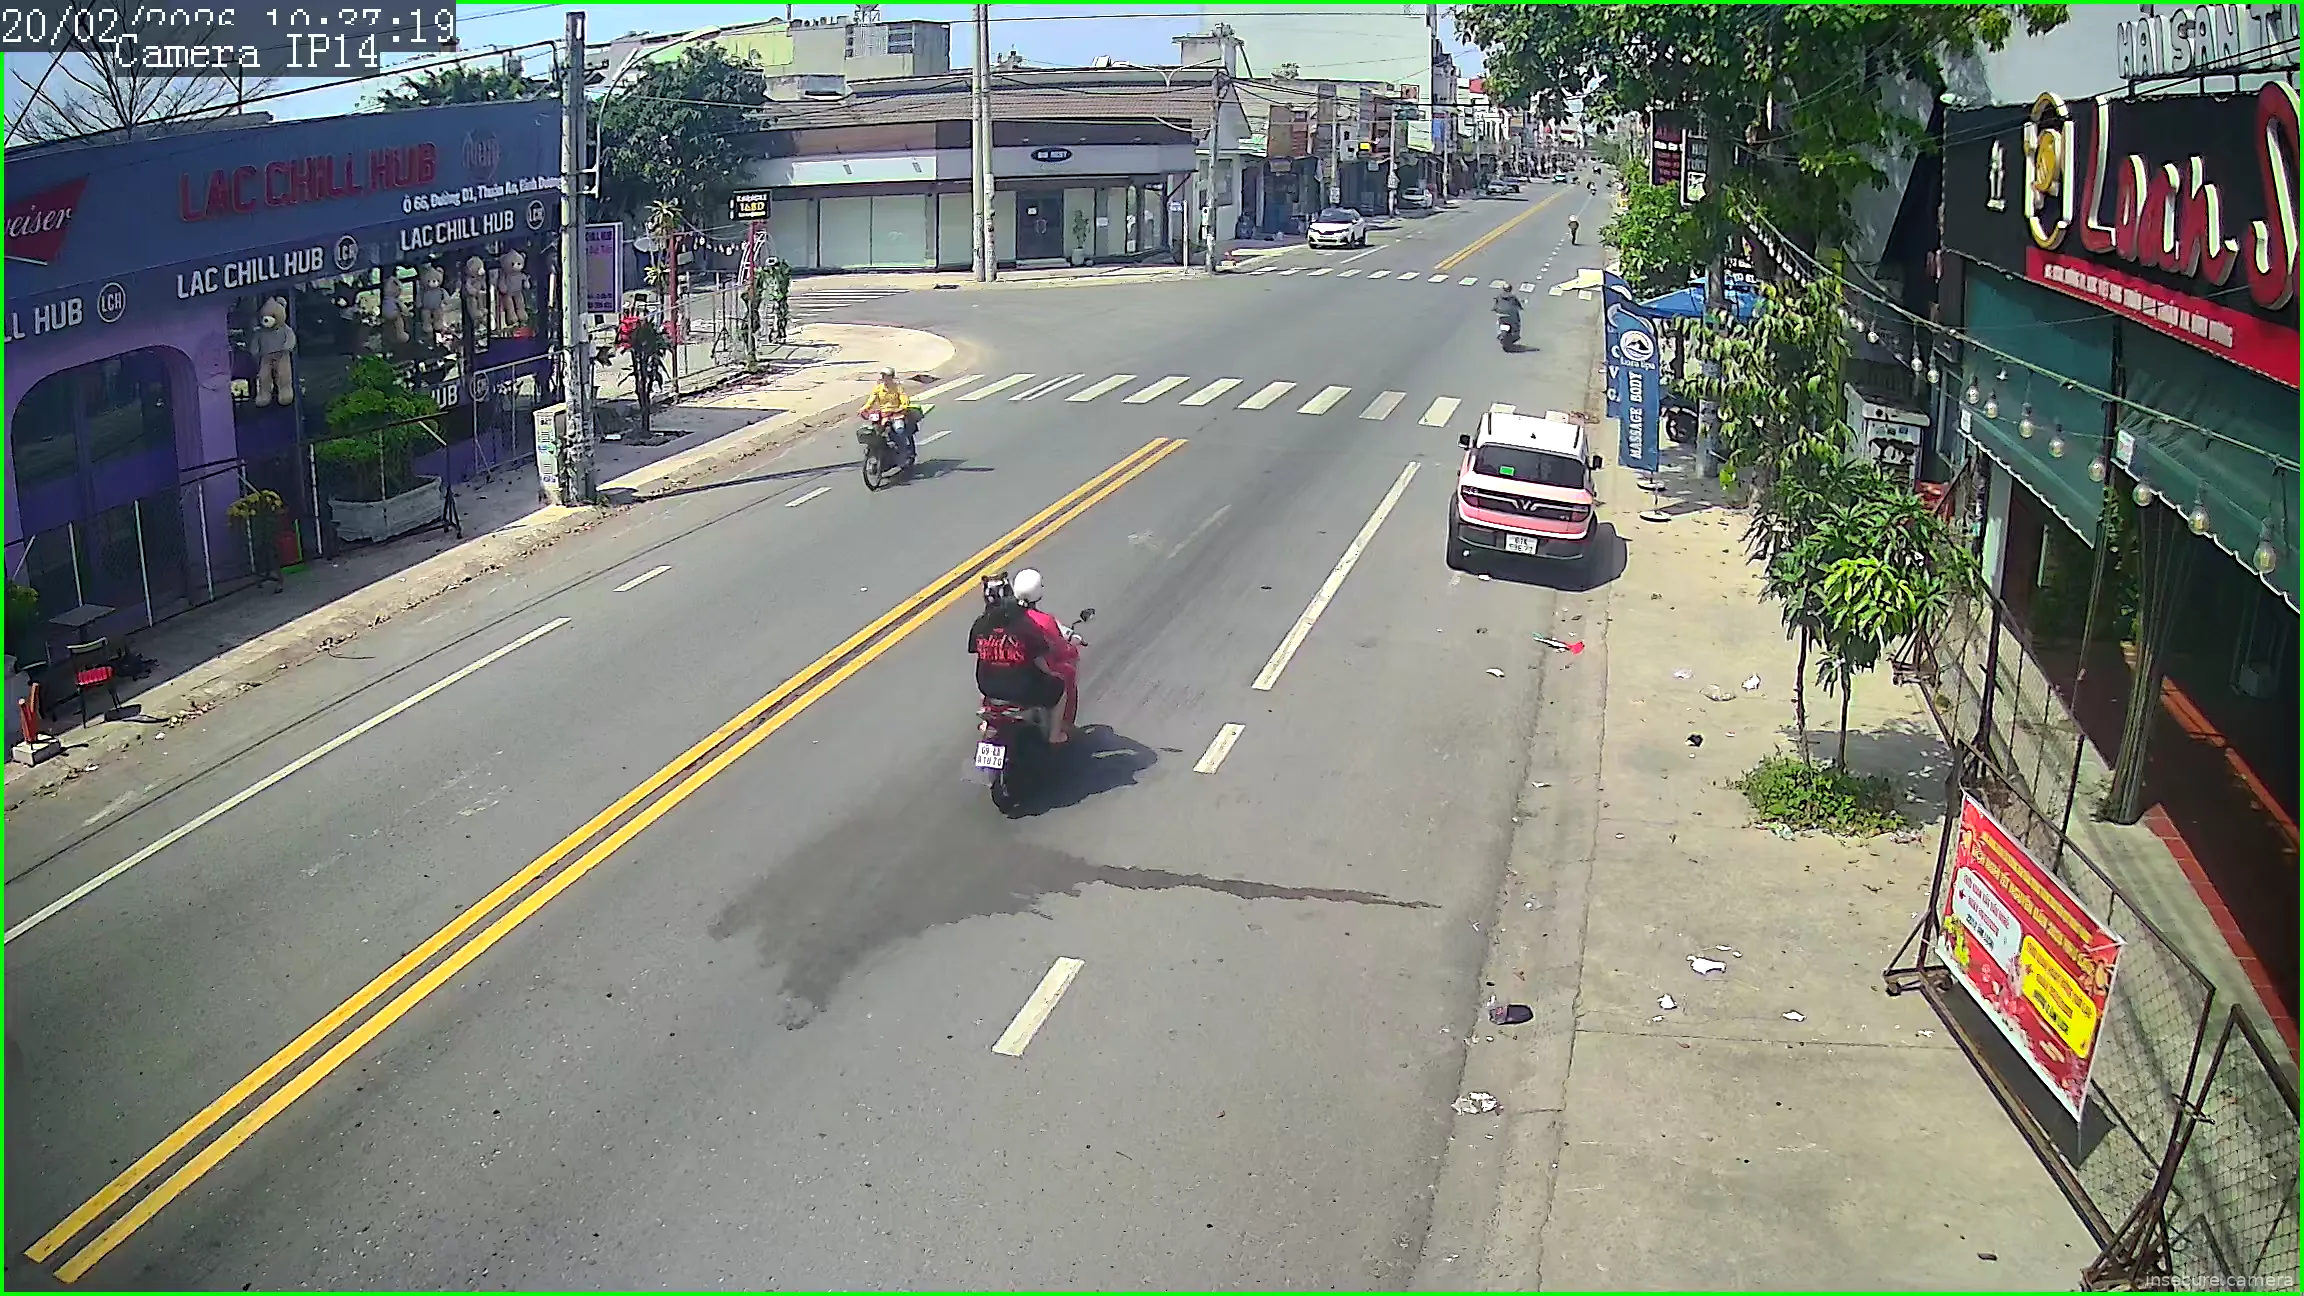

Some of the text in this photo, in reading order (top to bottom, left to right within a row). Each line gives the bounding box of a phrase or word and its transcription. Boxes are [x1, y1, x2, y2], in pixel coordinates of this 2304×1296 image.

[180, 164, 259, 222] LAC
[264, 151, 363, 207] CHILL
[369, 141, 438, 191] HUB
[401, 209, 515, 252] LAC CHILL HUB
[176, 246, 324, 299] LAC CHILL HUB
[34, 298, 83, 334] HUB
[101, 291, 122, 312] LCH
[1628, 370, 1643, 460] MASSAGE BODY
